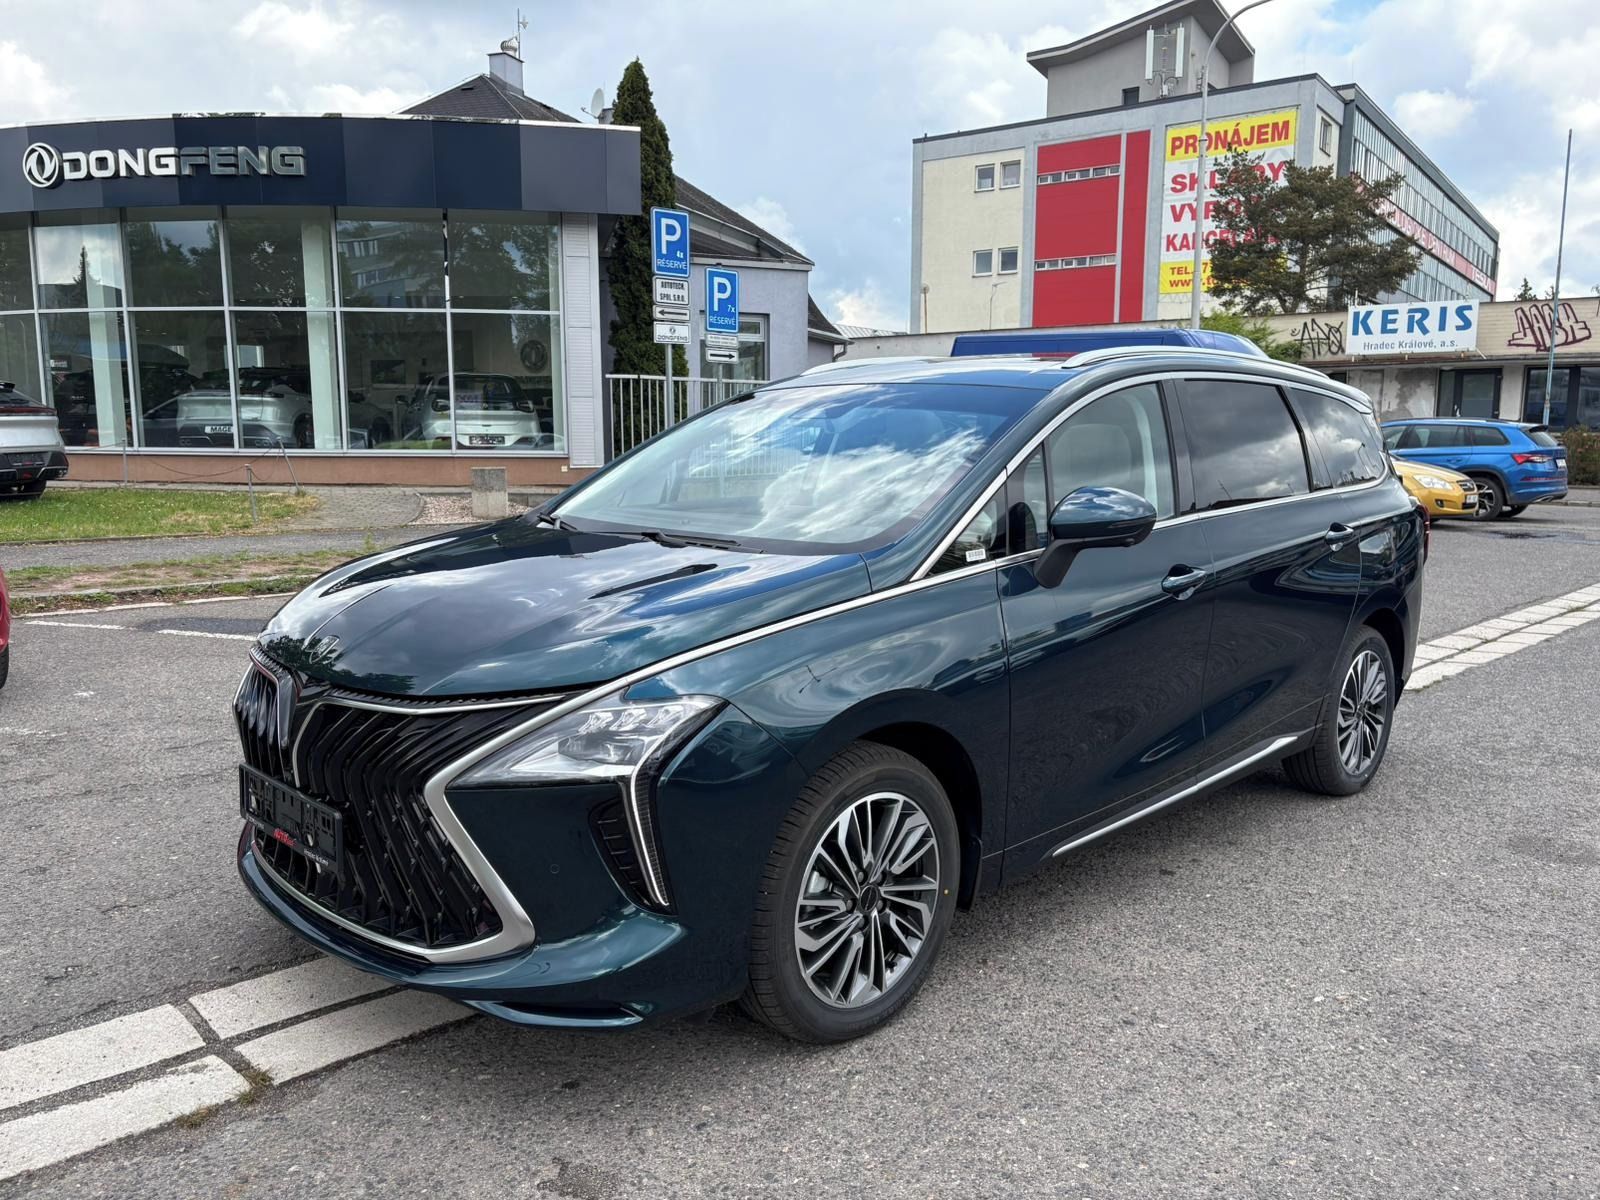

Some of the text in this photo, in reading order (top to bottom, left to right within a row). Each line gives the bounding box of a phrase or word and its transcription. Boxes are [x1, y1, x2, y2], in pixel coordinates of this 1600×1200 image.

[62, 146, 306, 180] DONGFENG
[661, 217, 682, 255] P
[713, 276, 732, 312] P
[727, 304, 736, 313] 7x
[1352, 305, 1473, 336] KERIS
[1363, 338, 1458, 351] Hradec Králové, a.s.
